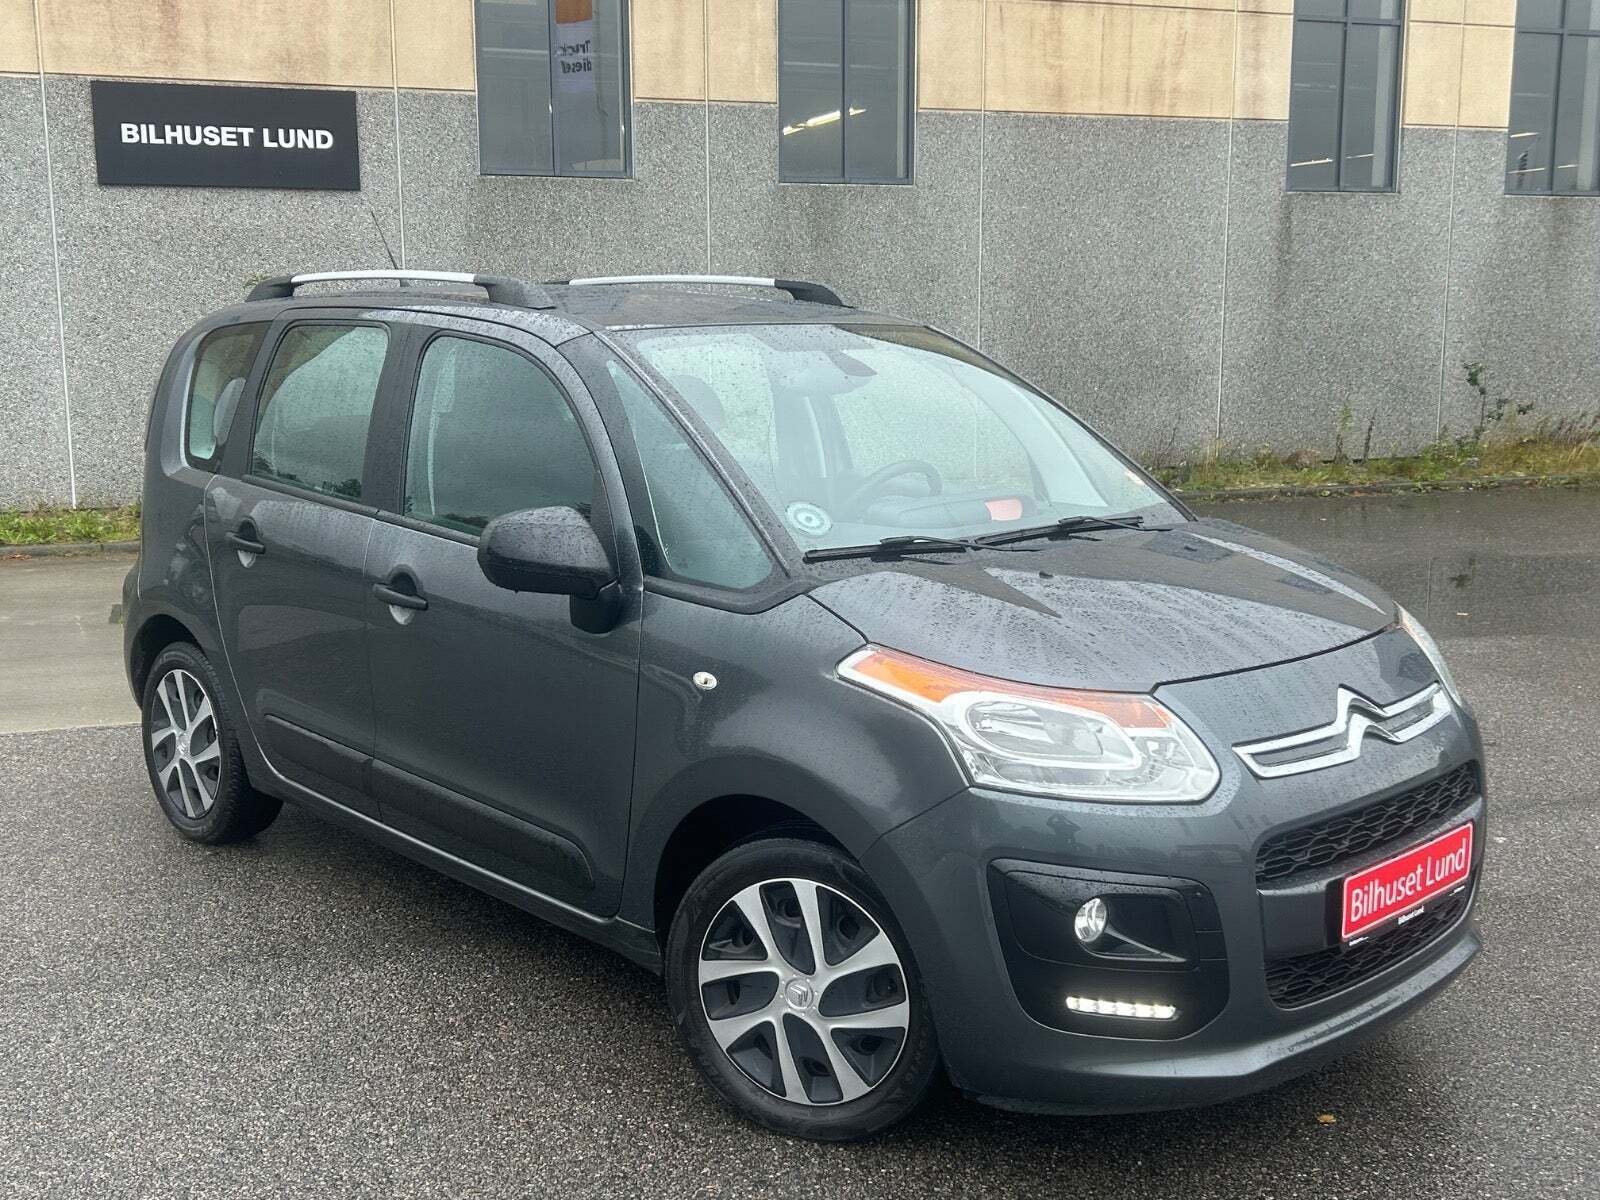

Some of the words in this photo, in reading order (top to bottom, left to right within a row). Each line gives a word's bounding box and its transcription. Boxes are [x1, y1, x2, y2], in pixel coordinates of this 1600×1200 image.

[120, 122, 254, 147] BILHUSET
[262, 127, 334, 150] LUND
[1350, 863, 1423, 923] Bilhuset
[1425, 837, 1467, 887] Lund
